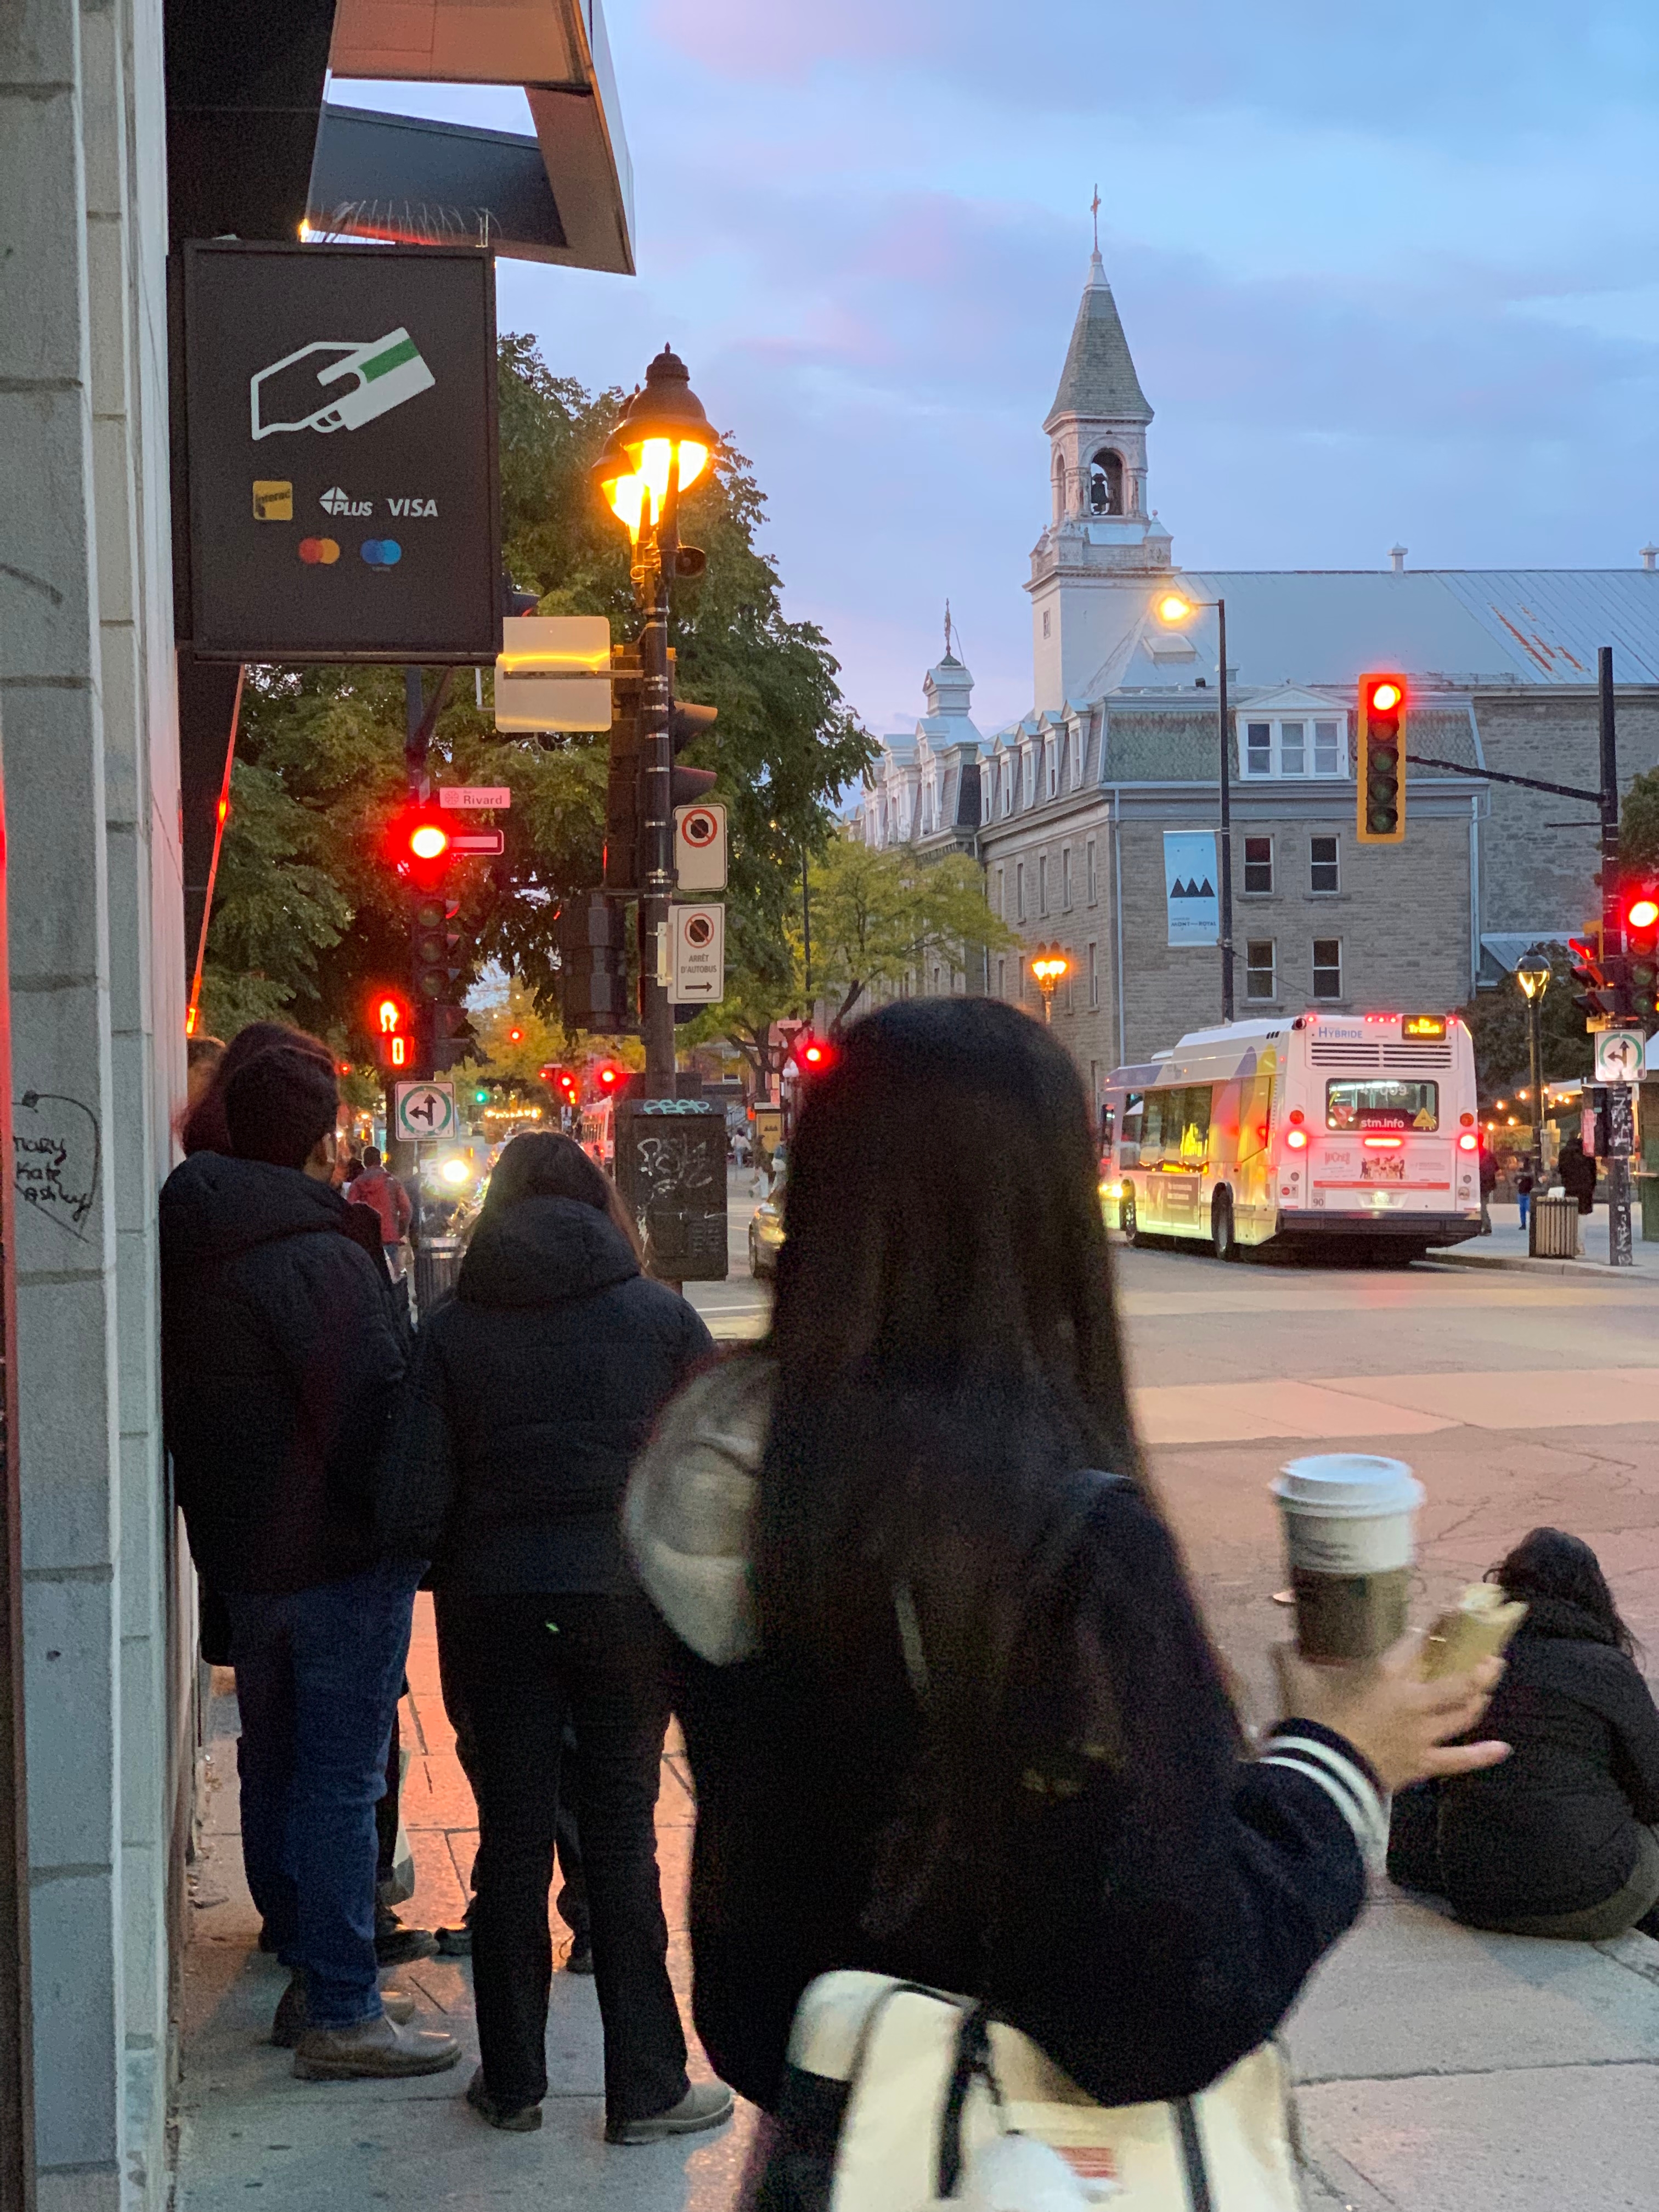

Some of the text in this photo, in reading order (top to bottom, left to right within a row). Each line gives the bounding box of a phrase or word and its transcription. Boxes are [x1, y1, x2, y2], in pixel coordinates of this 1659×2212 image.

[332, 501, 374, 516] PLUS
[386, 498, 438, 517] VISA
[464, 795, 502, 804] Rivard
[689, 952, 709, 962] ARRÊT
[681, 965, 717, 973] D'AUTOBUS
[1318, 1027, 1363, 1039] HYBRIDE
[1361, 1118, 1404, 1128] stm.info
[1313, 1198, 1324, 1206] 90
